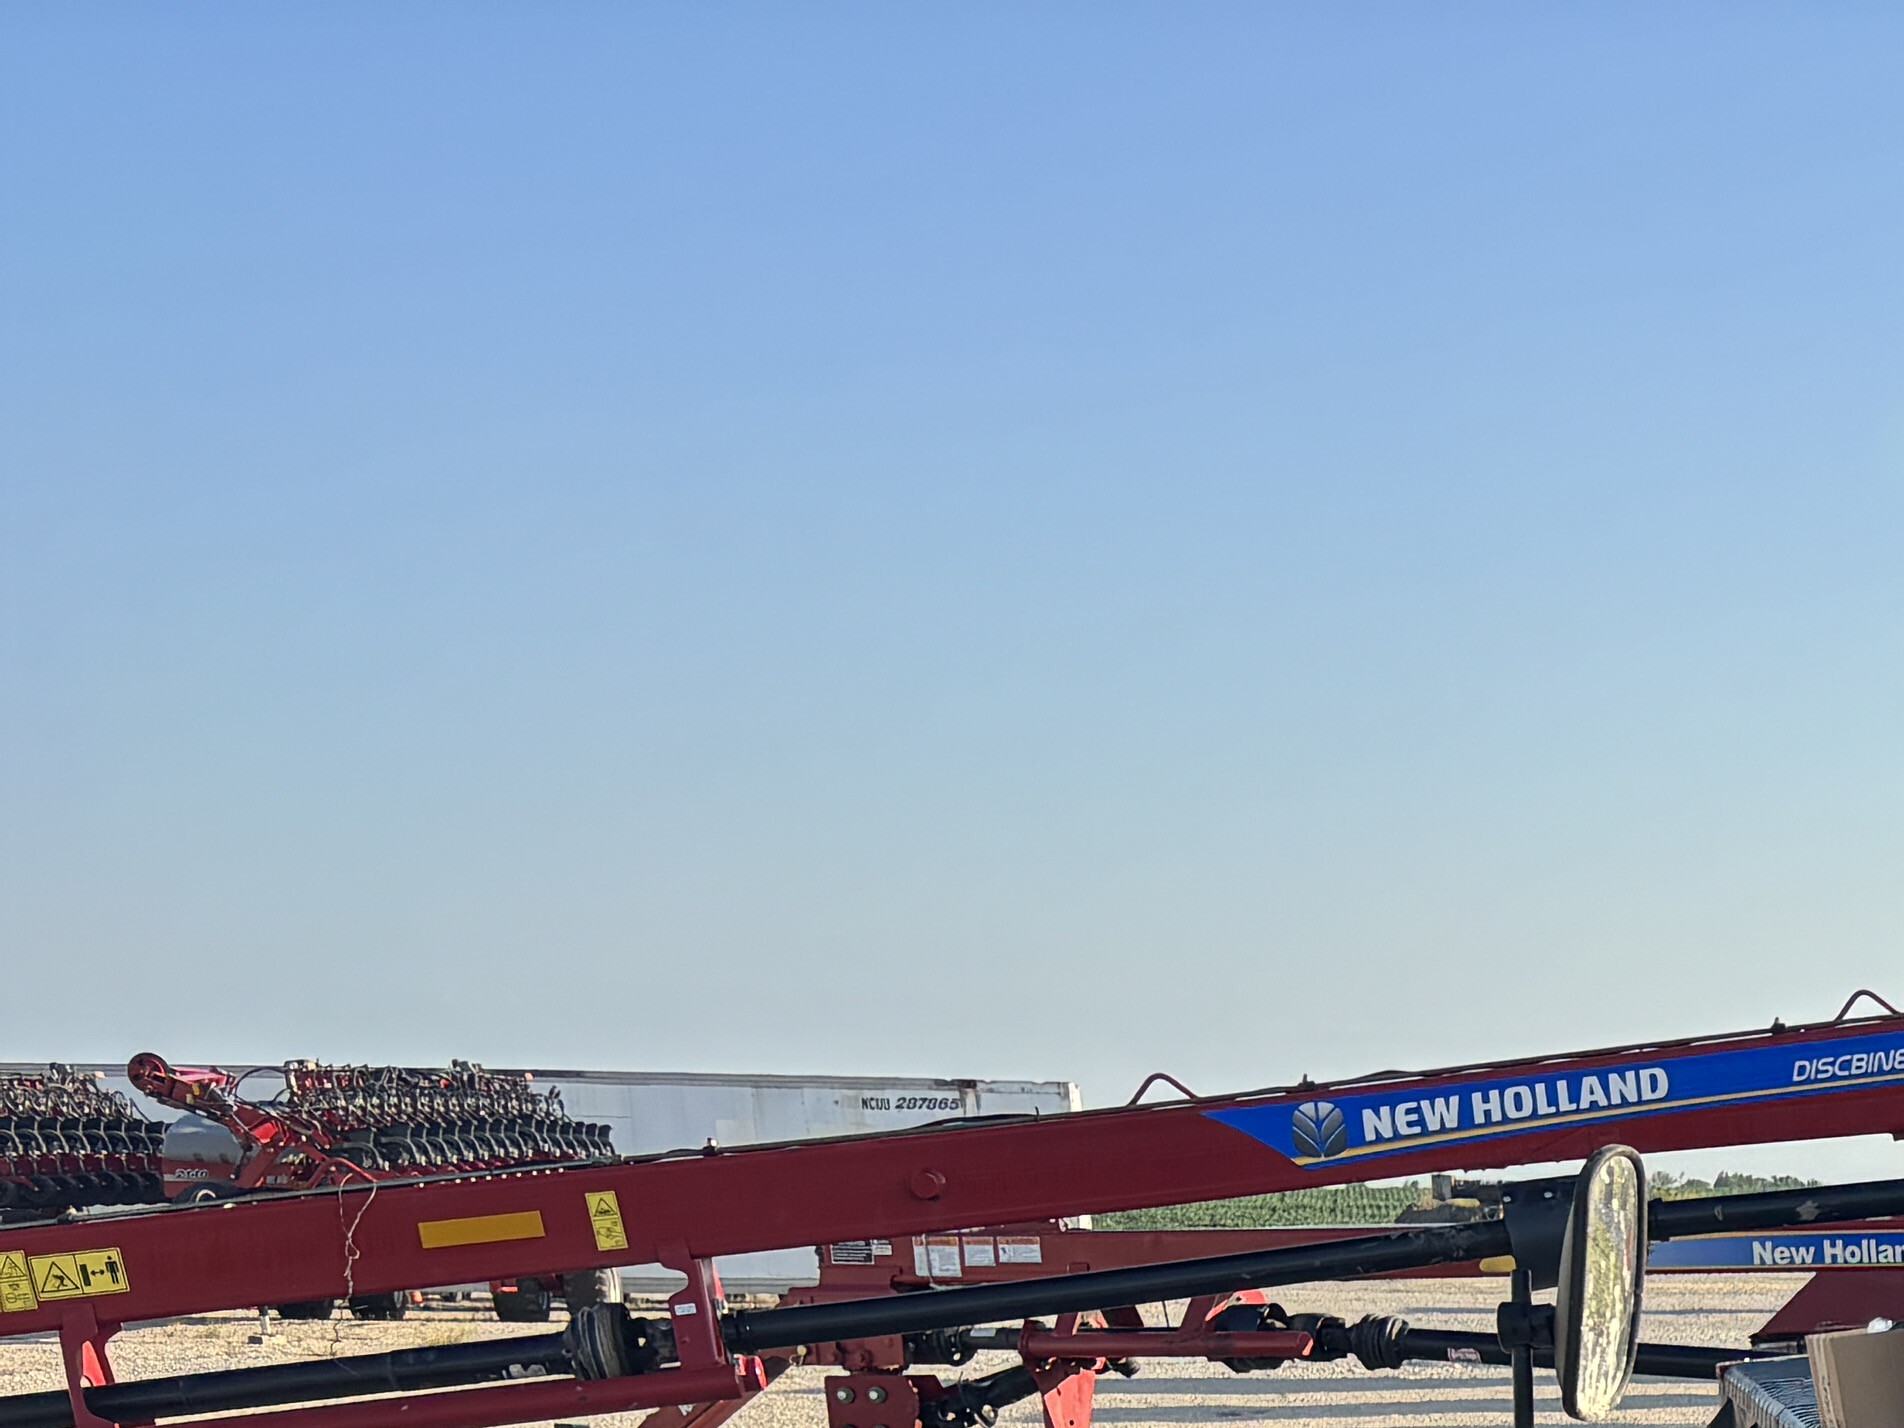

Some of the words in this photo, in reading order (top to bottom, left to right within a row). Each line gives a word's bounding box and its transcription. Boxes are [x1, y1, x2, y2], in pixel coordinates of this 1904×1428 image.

[1361, 1093, 1460, 1142] NEW
[1472, 1067, 1670, 1127] HOLLAND
[1752, 1239, 1815, 1266] New
